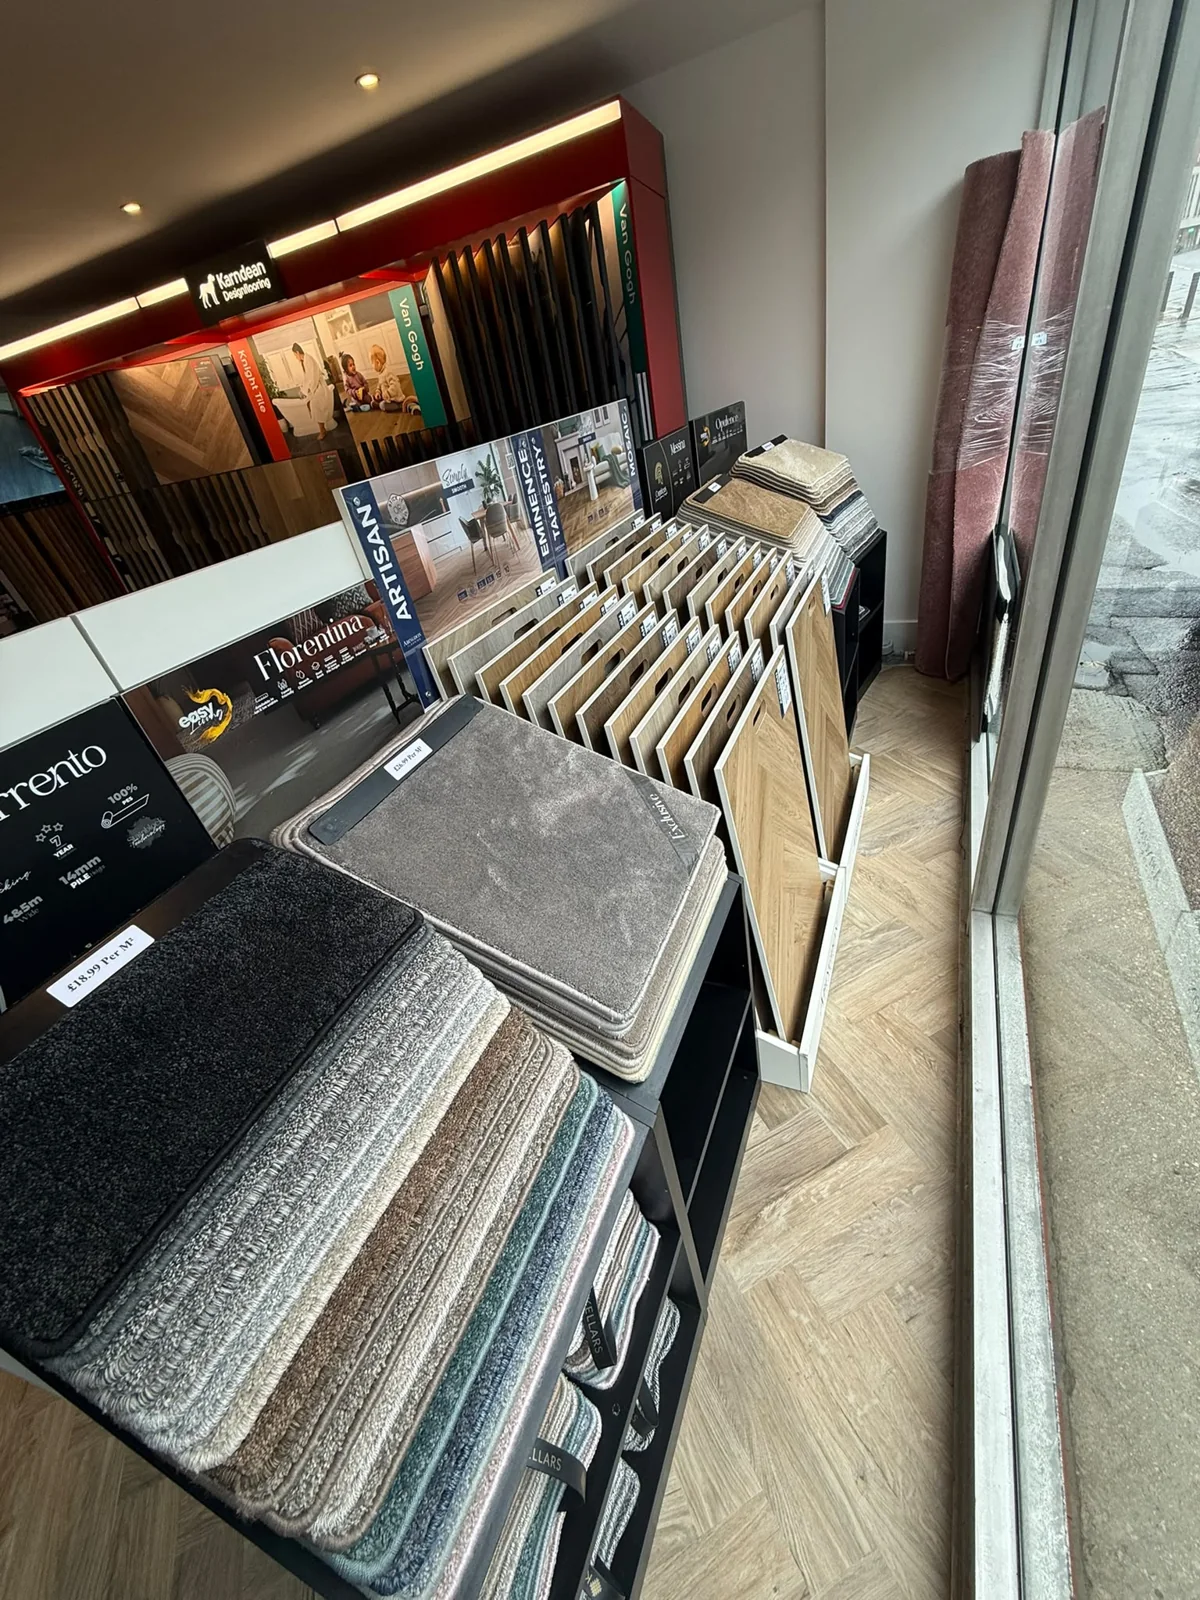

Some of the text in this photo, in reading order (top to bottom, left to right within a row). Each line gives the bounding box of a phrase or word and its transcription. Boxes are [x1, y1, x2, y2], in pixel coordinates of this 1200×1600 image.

[620, 203, 636, 304] Van Gogh
[216, 262, 266, 290] Karndean
[222, 278, 271, 302] Designflooring
[400, 298, 424, 370] Van Gogh
[238, 350, 266, 413] Knight Tile
[253, 615, 365, 681] Florentina
[178, 702, 215, 728] easy
[406, 752, 417, 761] Per
[107, 783, 138, 804] 100%
[122, 796, 133, 805] PES
[649, 793, 686, 840] Exclusive
[49, 834, 62, 847] 7
[53, 843, 74, 858] YEAR
[58, 855, 102, 885] 14mm
[70, 872, 91, 889] PILE
[3, 896, 43, 924] 4&5m
[67, 937, 134, 992] £18.99 Per M²
[528, 1447, 562, 1471] LLARS
